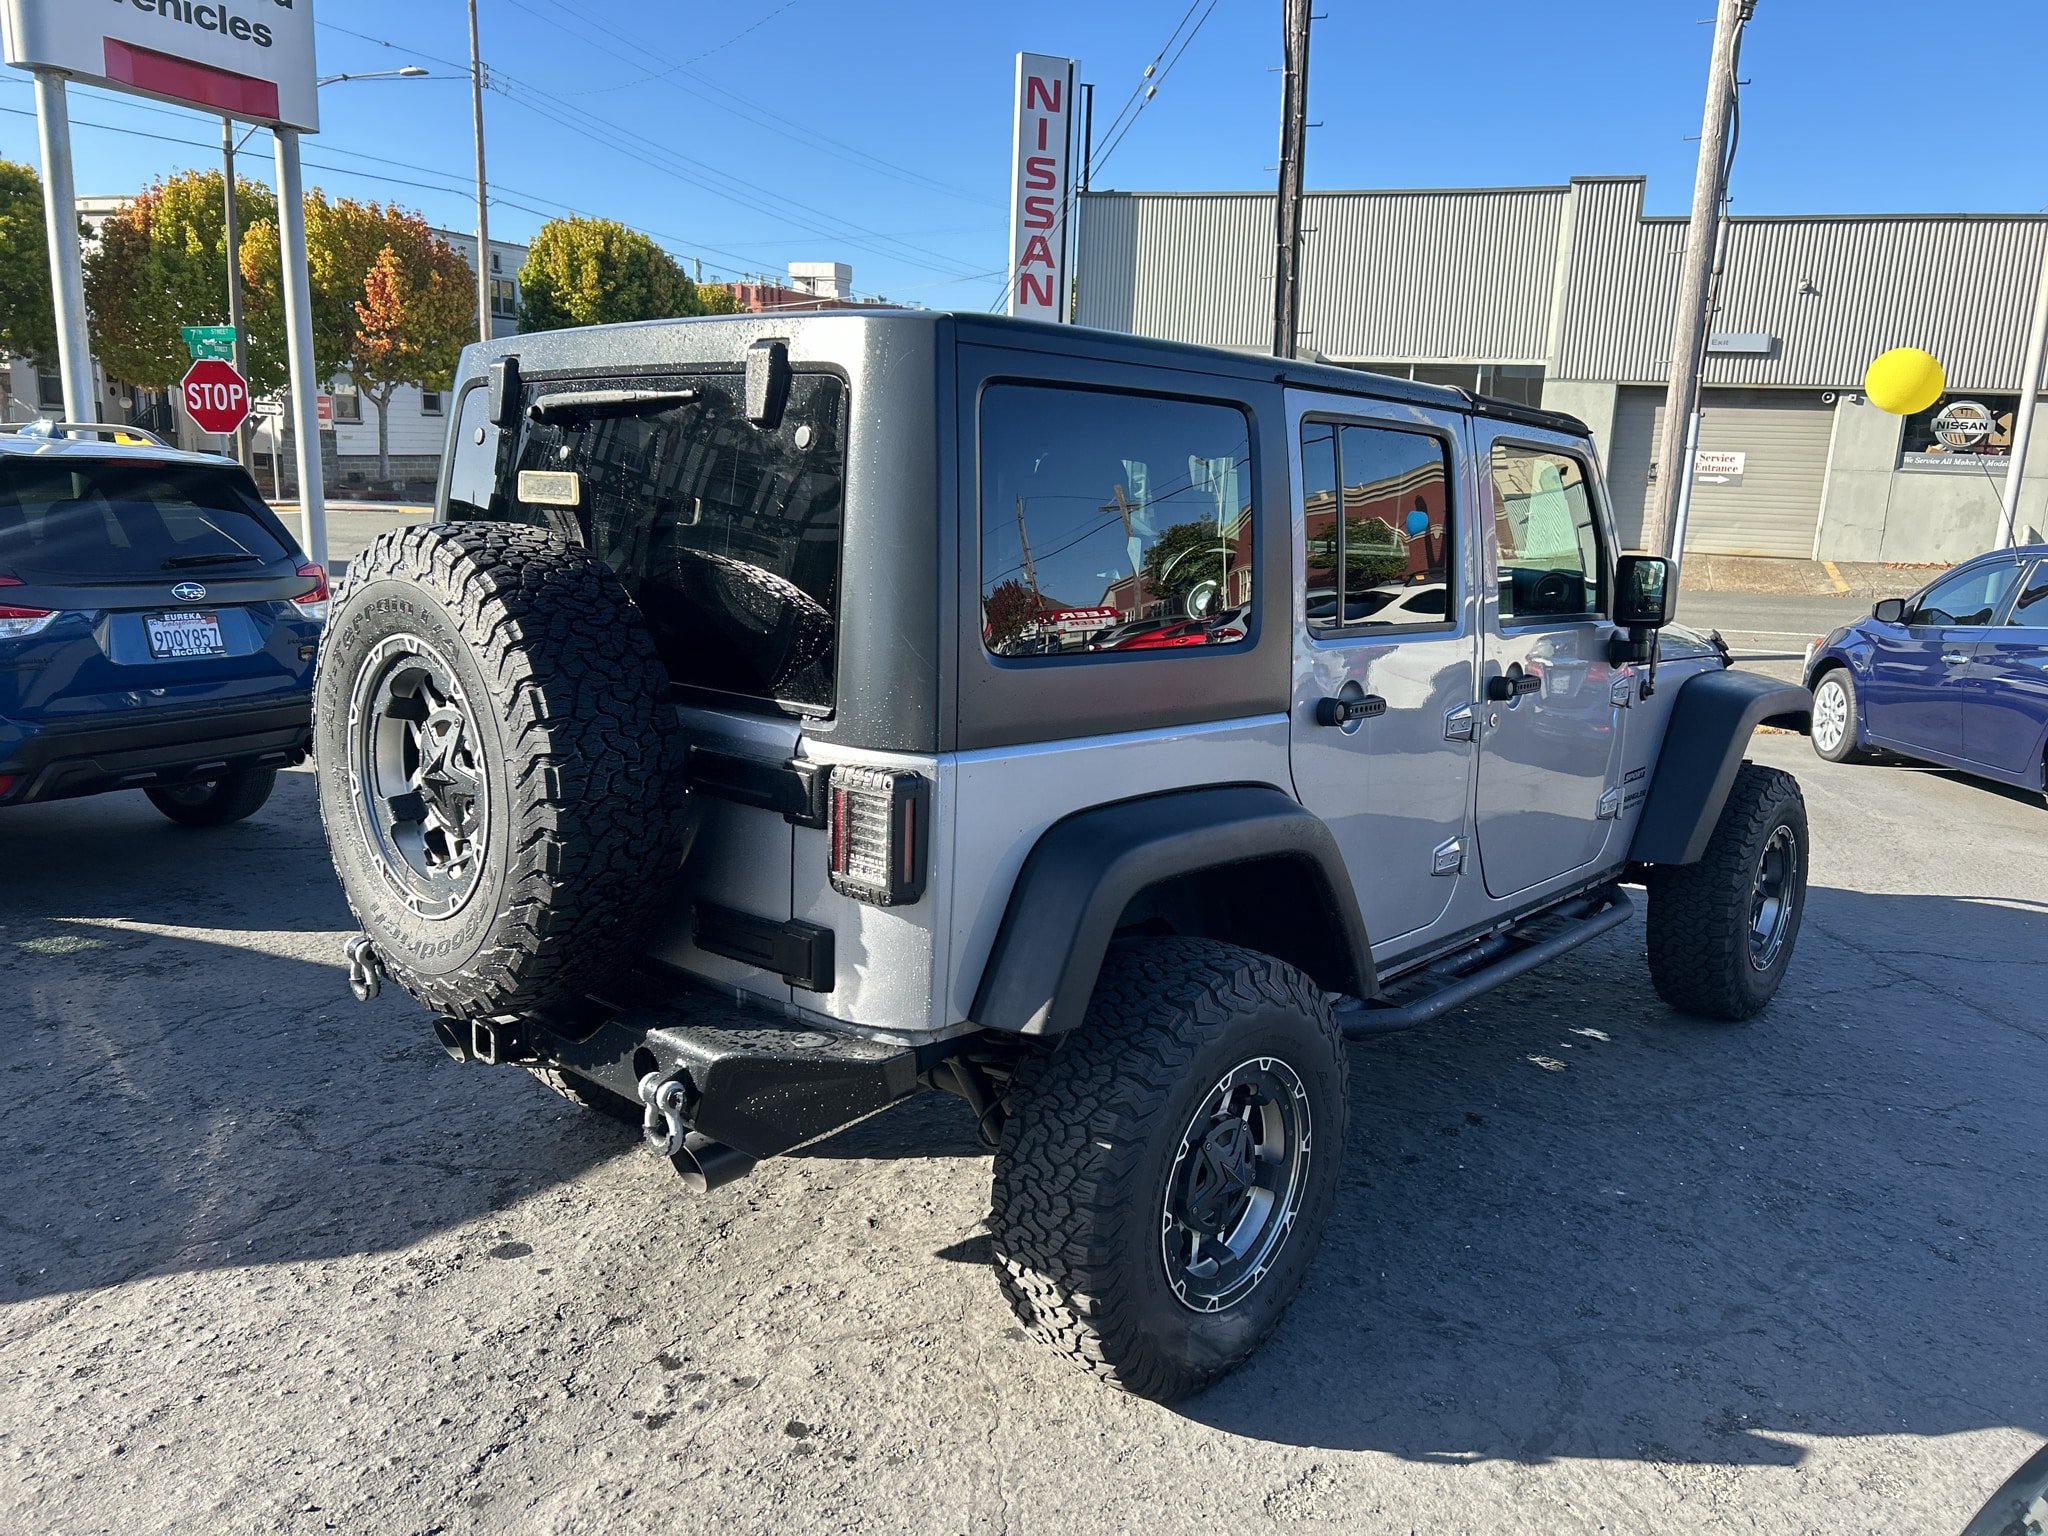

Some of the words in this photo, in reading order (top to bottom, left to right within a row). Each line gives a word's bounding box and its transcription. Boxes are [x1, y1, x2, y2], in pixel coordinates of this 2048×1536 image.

[1019, 76, 1062, 307] NISSAN
[197, 344, 203, 356] G
[187, 382, 243, 411] STOP
[1936, 421, 1988, 431] NISSAN
[1699, 453, 1736, 462] Service
[1914, 457, 1940, 465] Service
[1940, 457, 1952, 465] All
[1953, 458, 1976, 466] Makes
[1695, 462, 1739, 472] Entrance
[164, 613, 201, 621] EUREKA
[171, 647, 212, 657] McCREA
